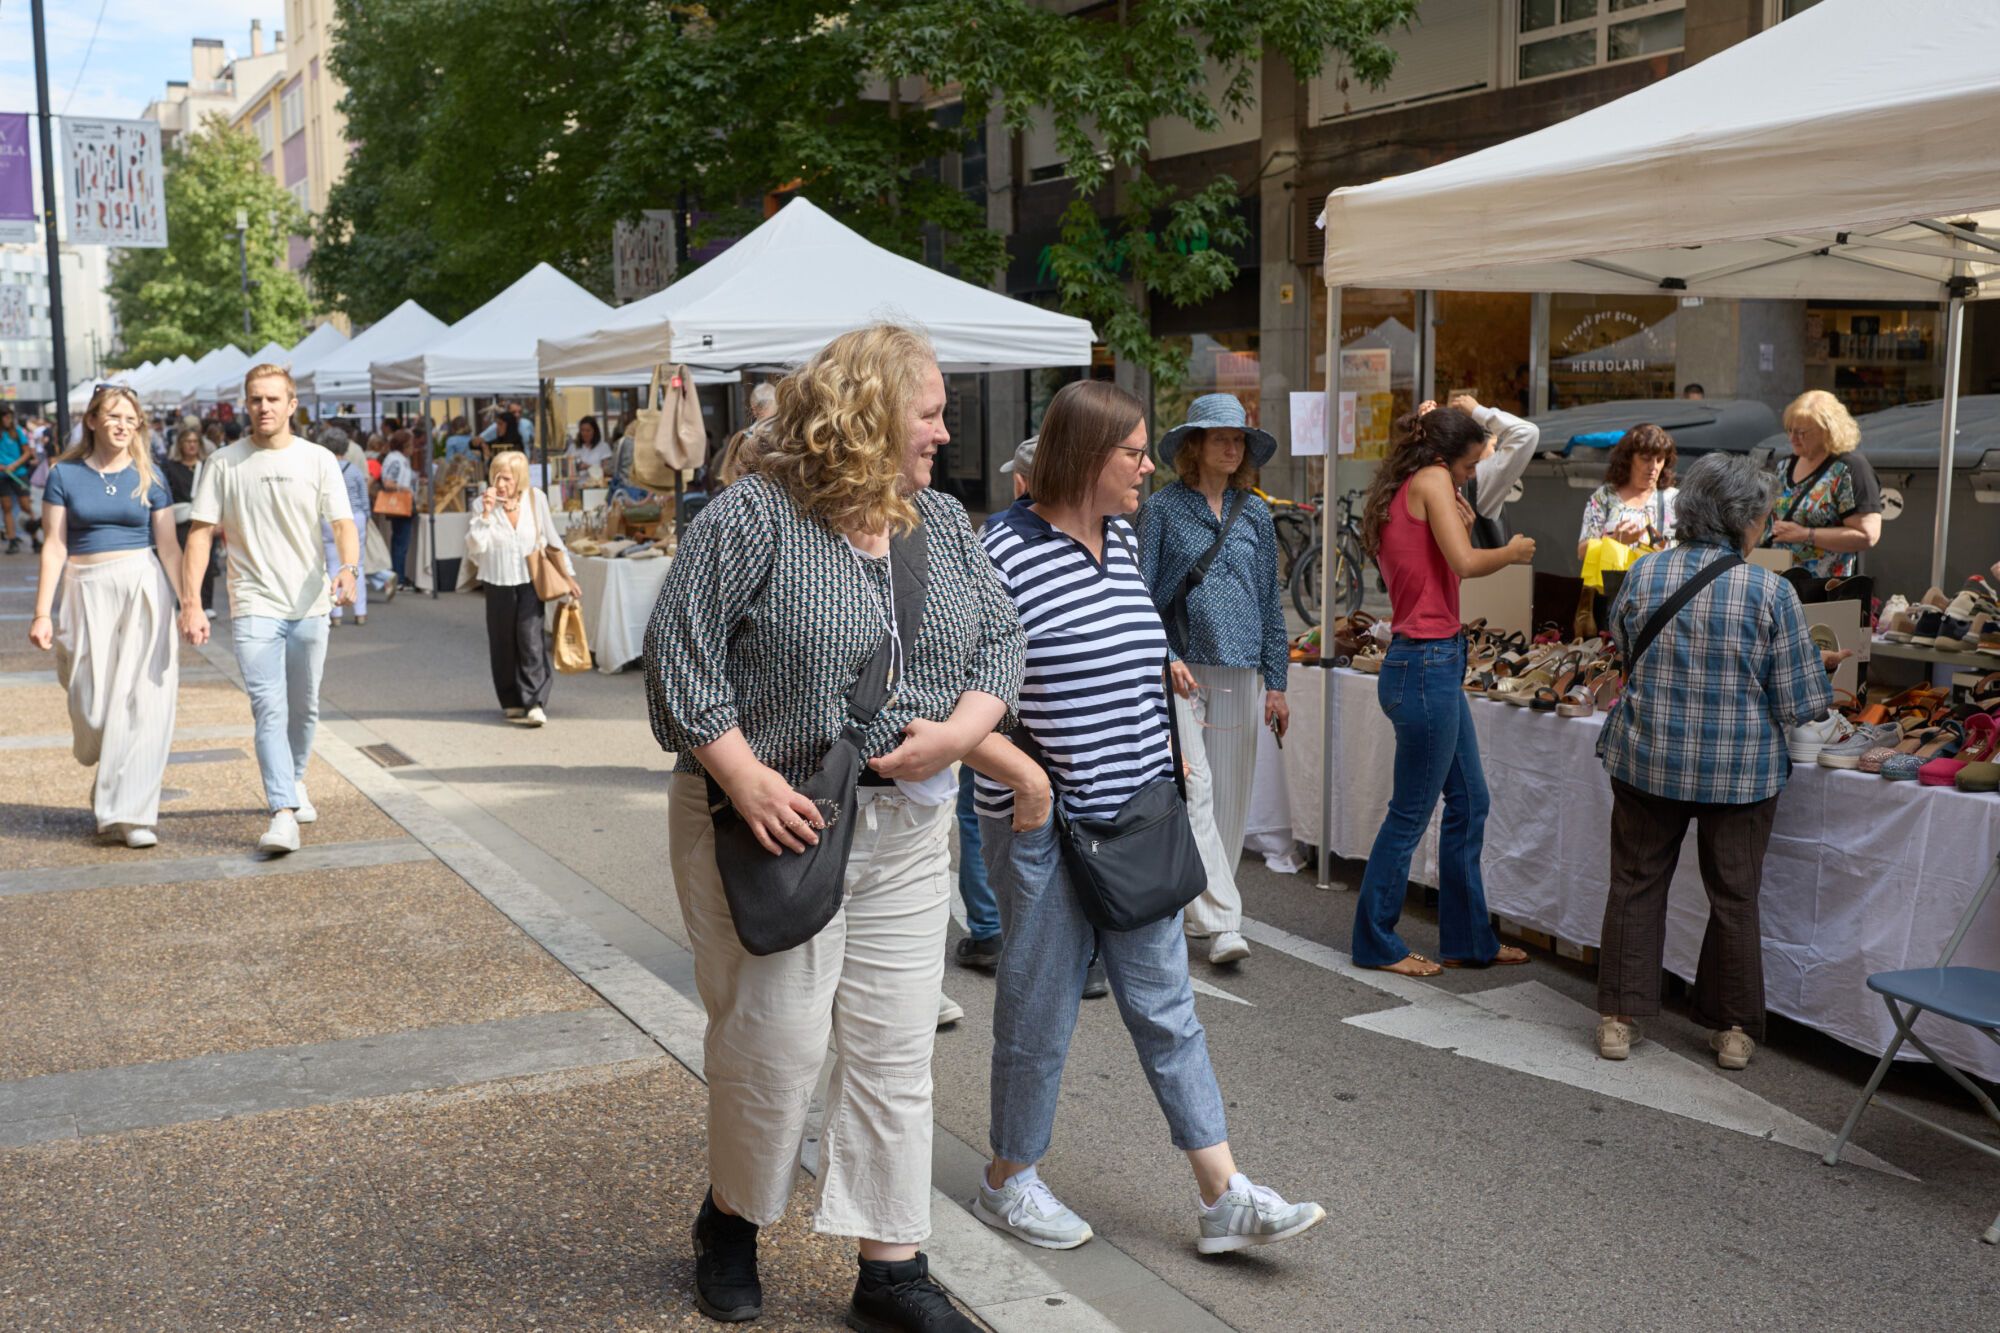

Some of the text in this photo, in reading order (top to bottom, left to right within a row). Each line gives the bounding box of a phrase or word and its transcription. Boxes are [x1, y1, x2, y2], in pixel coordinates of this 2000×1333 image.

[1594, 311, 1611, 325] per
[1614, 310, 1638, 325] gent
[1572, 359, 1645, 373] HERBOLARI
